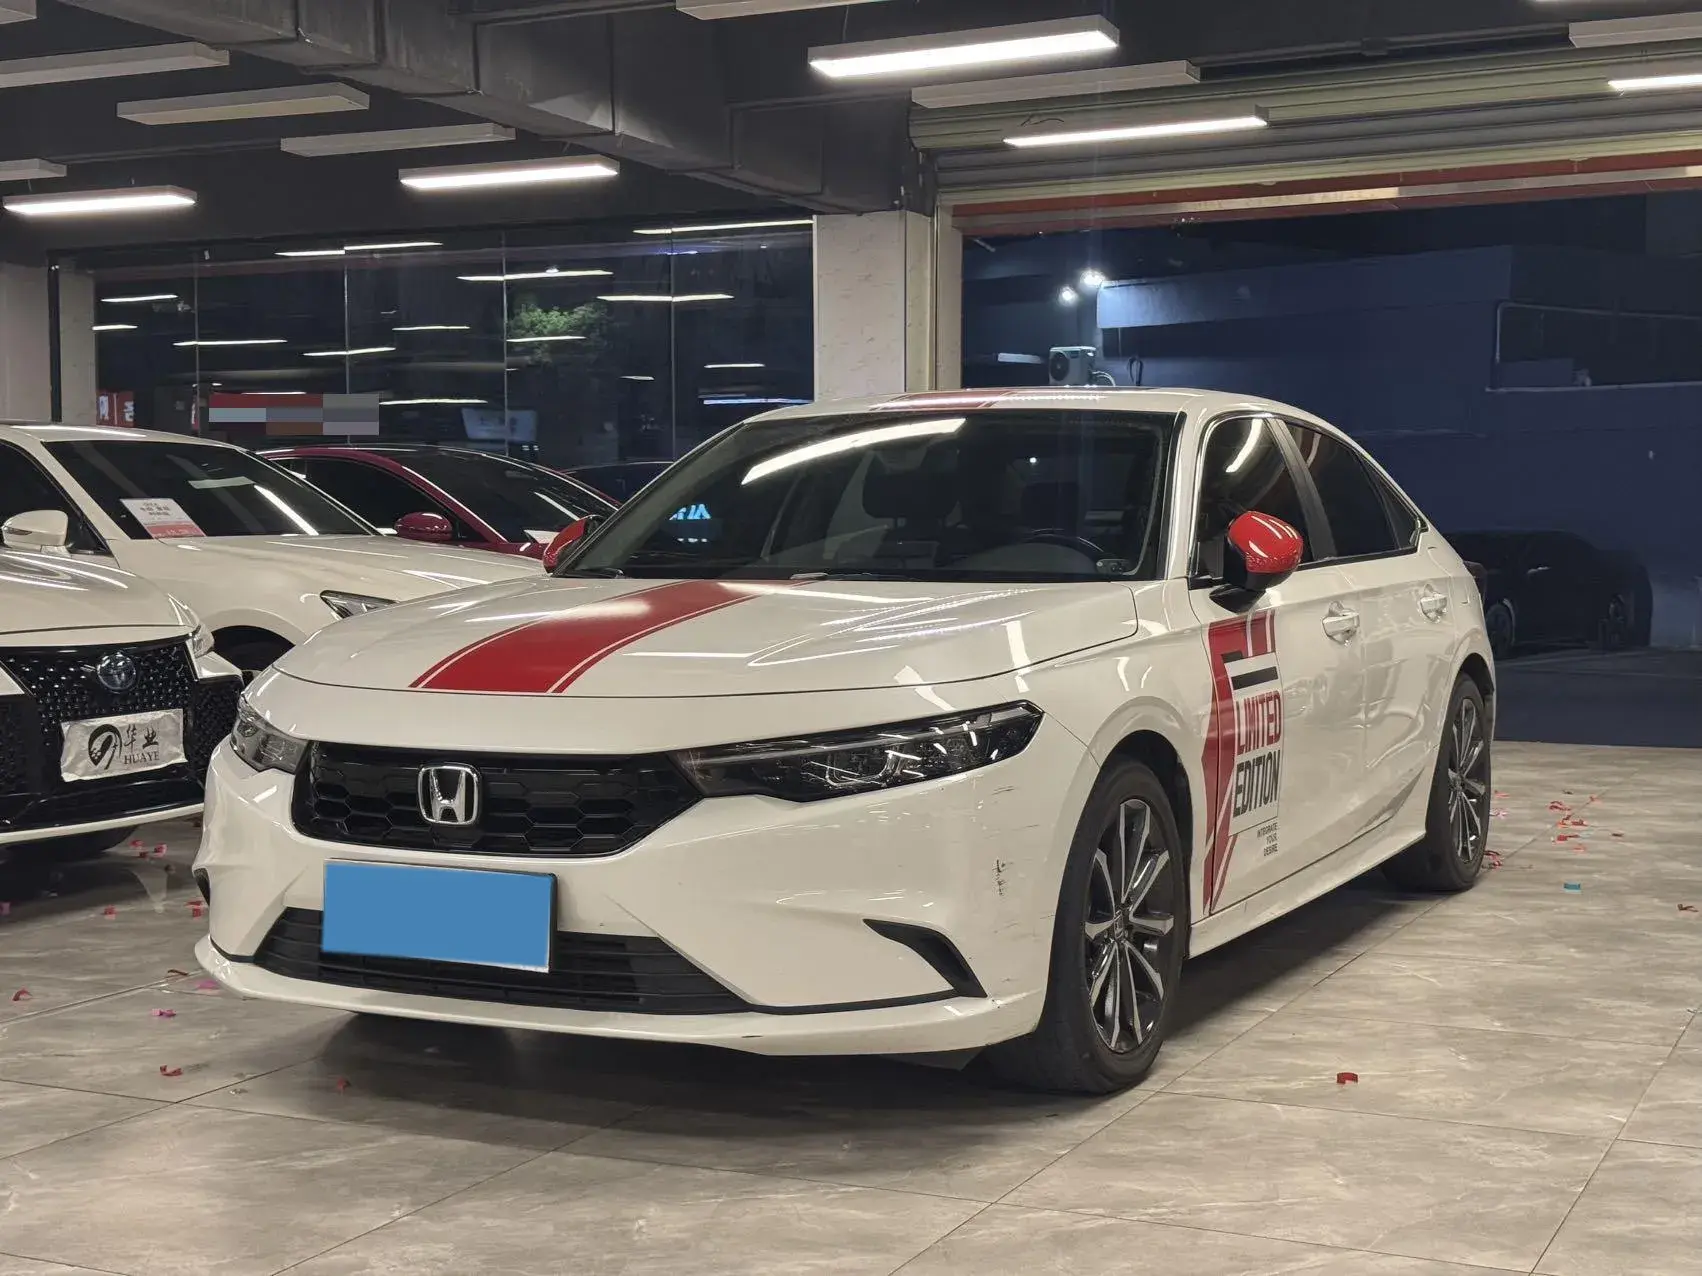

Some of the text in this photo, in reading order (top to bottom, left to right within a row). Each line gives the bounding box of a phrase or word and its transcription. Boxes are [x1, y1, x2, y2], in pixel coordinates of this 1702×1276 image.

[124, 723, 159, 753] 华业
[1236, 690, 1281, 755] LIMITED
[124, 751, 160, 764] HUAYE
[1233, 750, 1280, 817] EDITION
